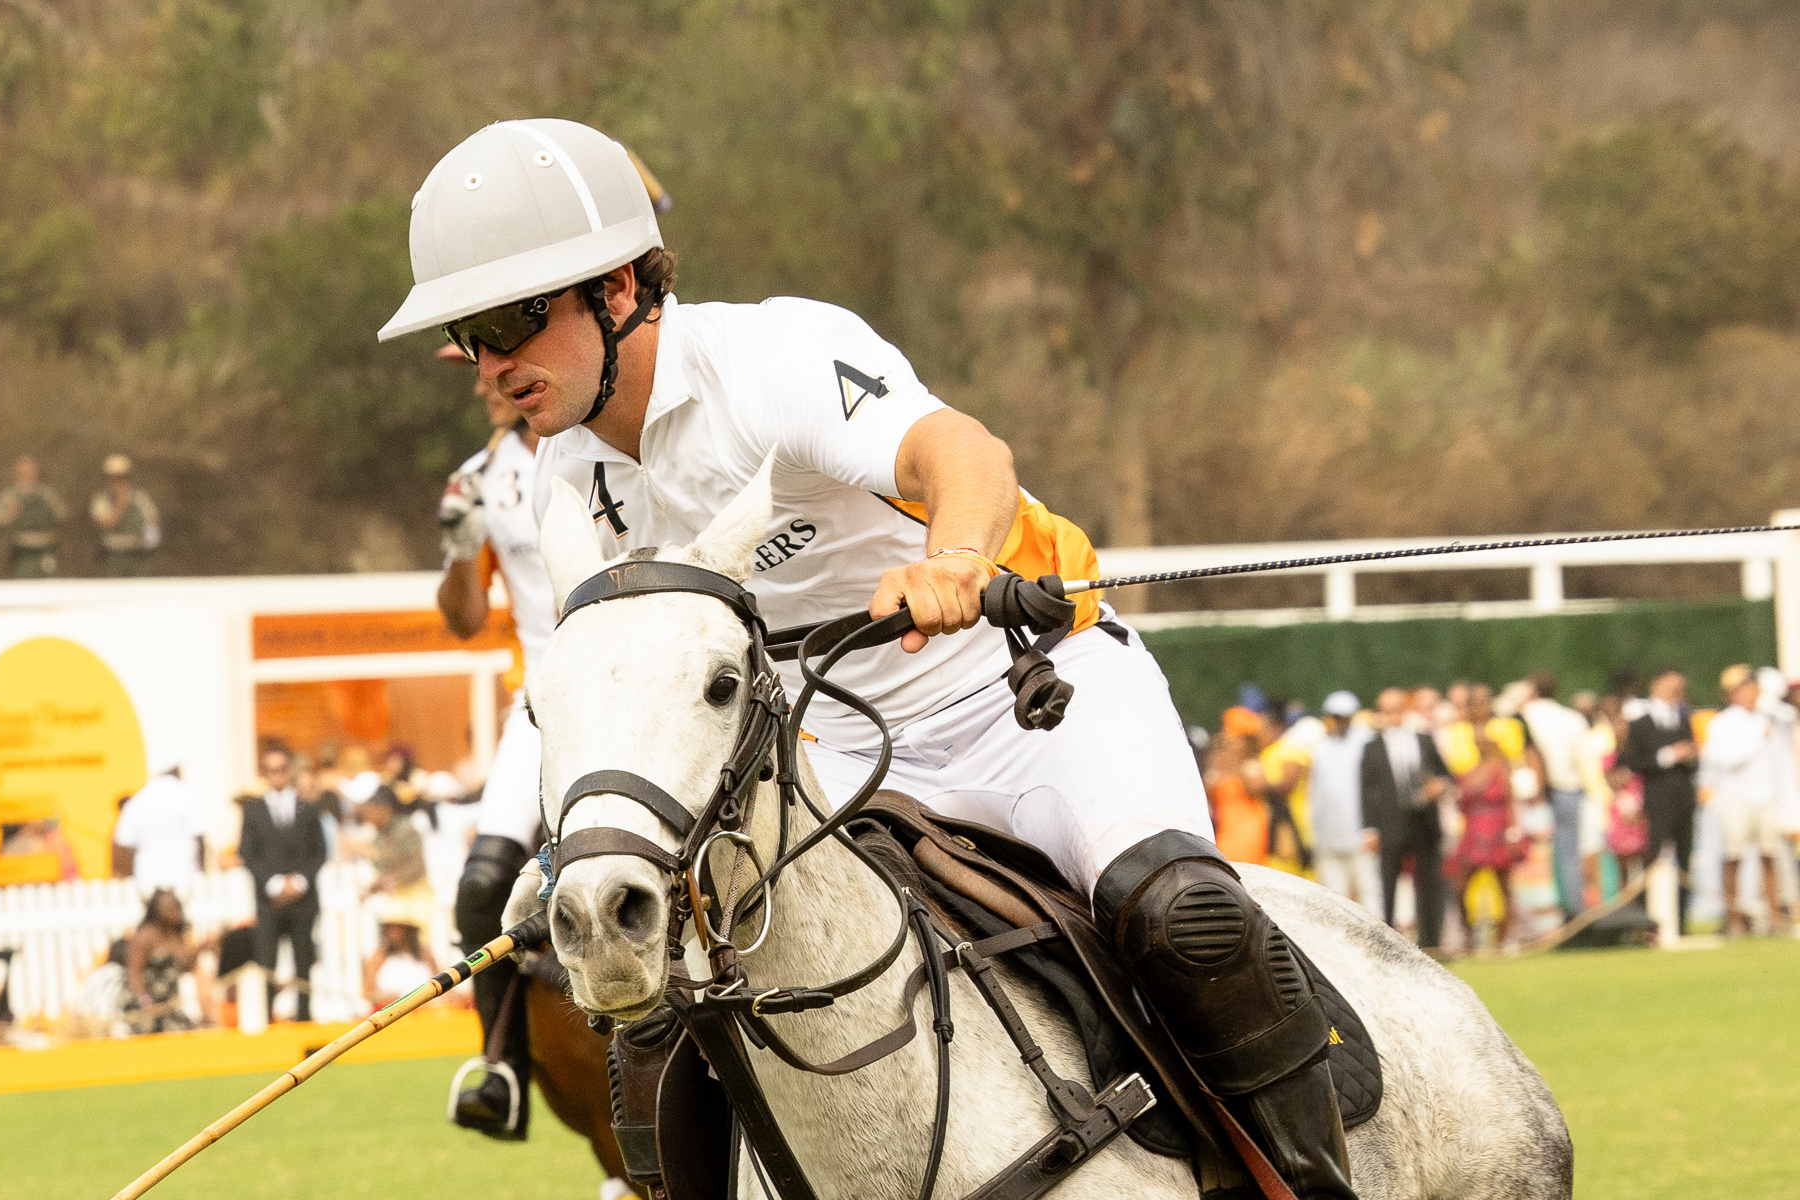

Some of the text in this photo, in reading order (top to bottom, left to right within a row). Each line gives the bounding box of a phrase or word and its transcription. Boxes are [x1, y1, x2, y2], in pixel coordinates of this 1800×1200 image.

[833, 359, 895, 421] 4
[497, 469, 523, 513] 3
[588, 461, 629, 539] 4
